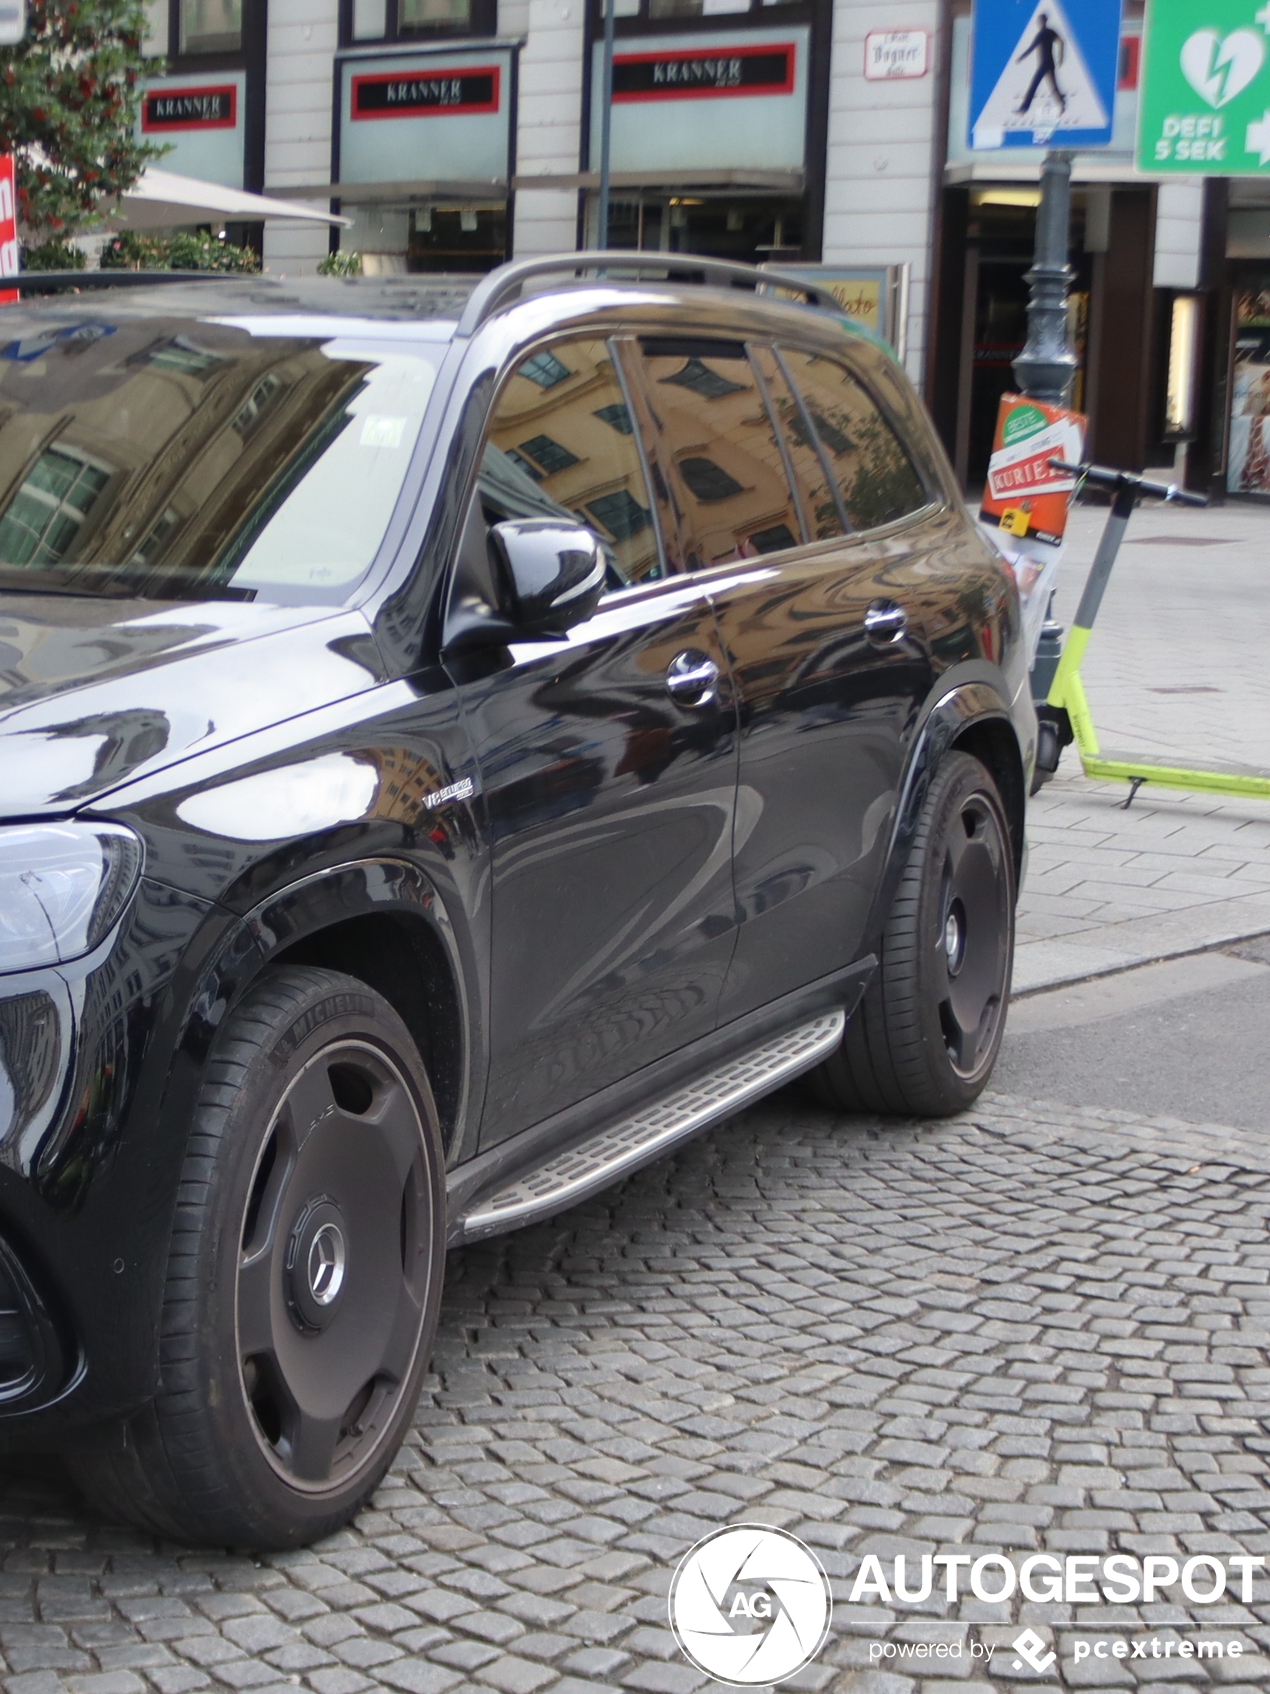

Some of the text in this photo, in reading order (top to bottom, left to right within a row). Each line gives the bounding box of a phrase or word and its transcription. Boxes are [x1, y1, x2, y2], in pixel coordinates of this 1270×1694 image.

[653, 57, 743, 83] KRANNER
[387, 78, 461, 102] KRANNER
[156, 94, 220, 117] KRANNER
[1162, 116, 1221, 138] DEFI
[1154, 139, 1227, 161] 5 SEK
